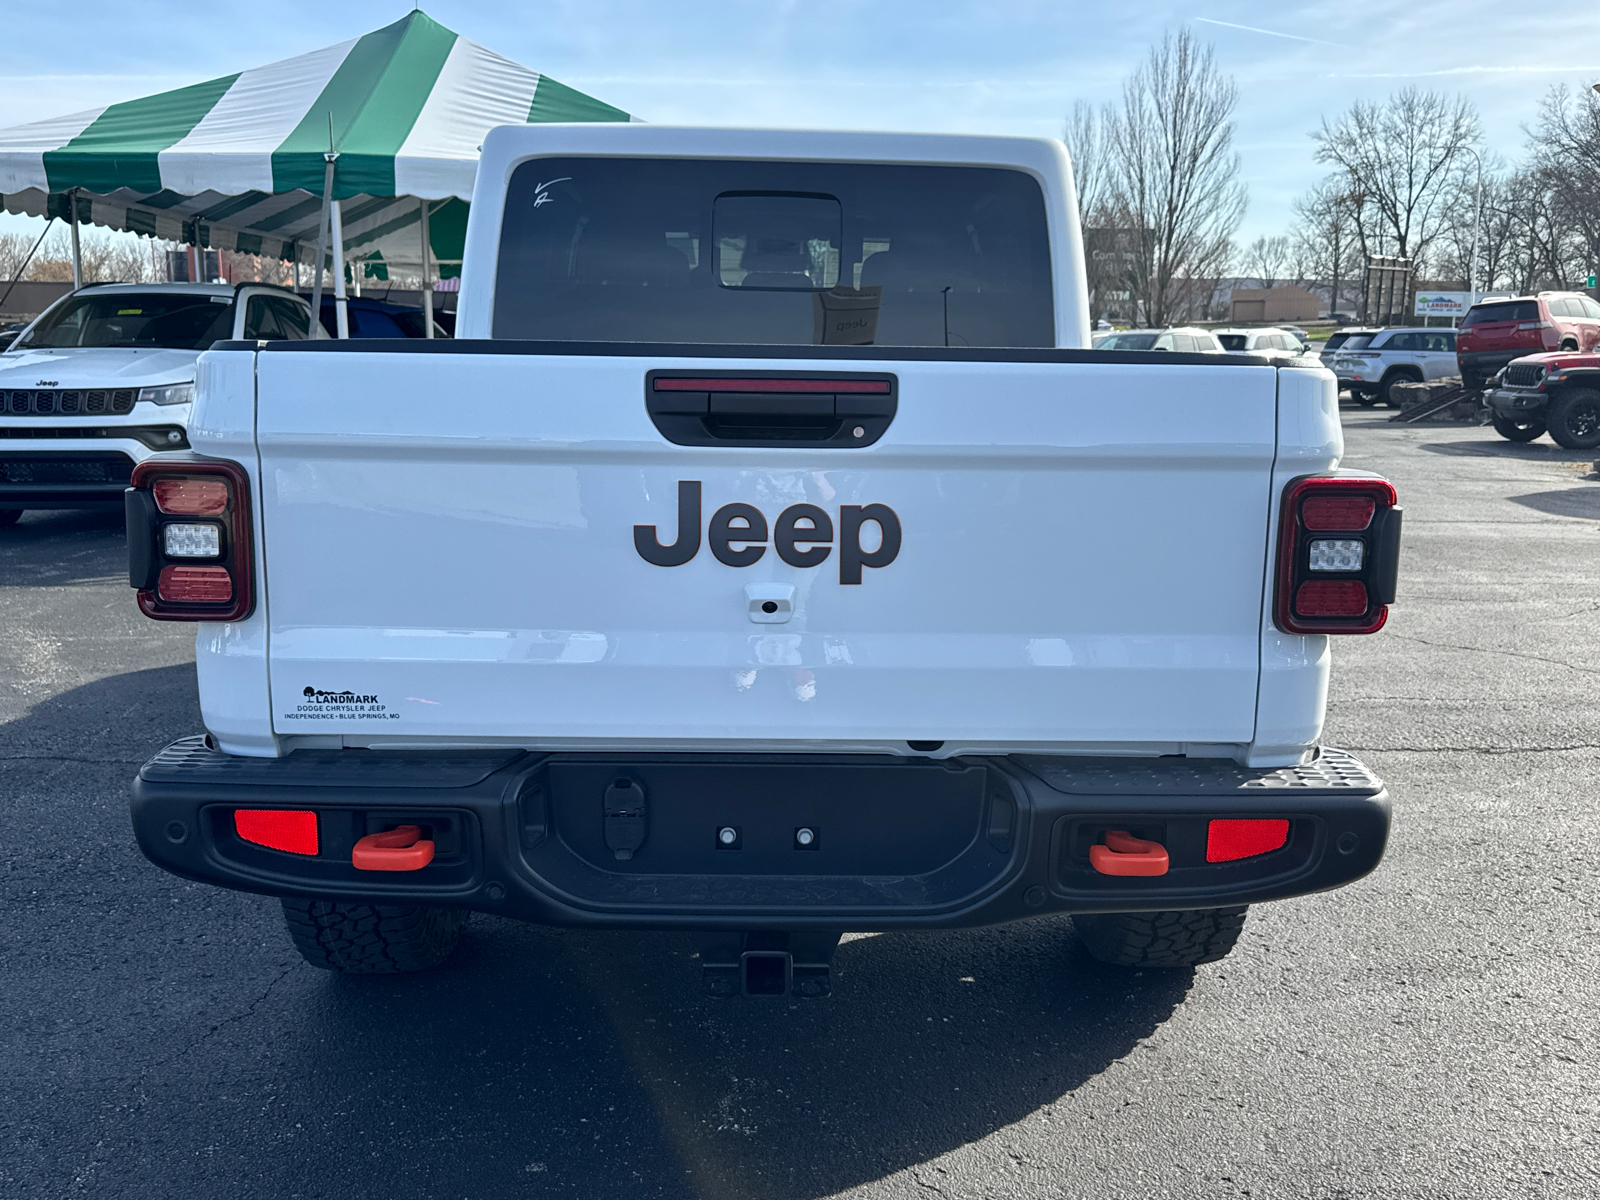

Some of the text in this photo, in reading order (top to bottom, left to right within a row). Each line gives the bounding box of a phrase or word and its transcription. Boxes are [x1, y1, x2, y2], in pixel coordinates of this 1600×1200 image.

[36, 379, 59, 387] Jeep
[633, 480, 902, 585] Jeep
[315, 695, 379, 704] LANDMARK
[357, 713, 389, 721] SPRINGS,
